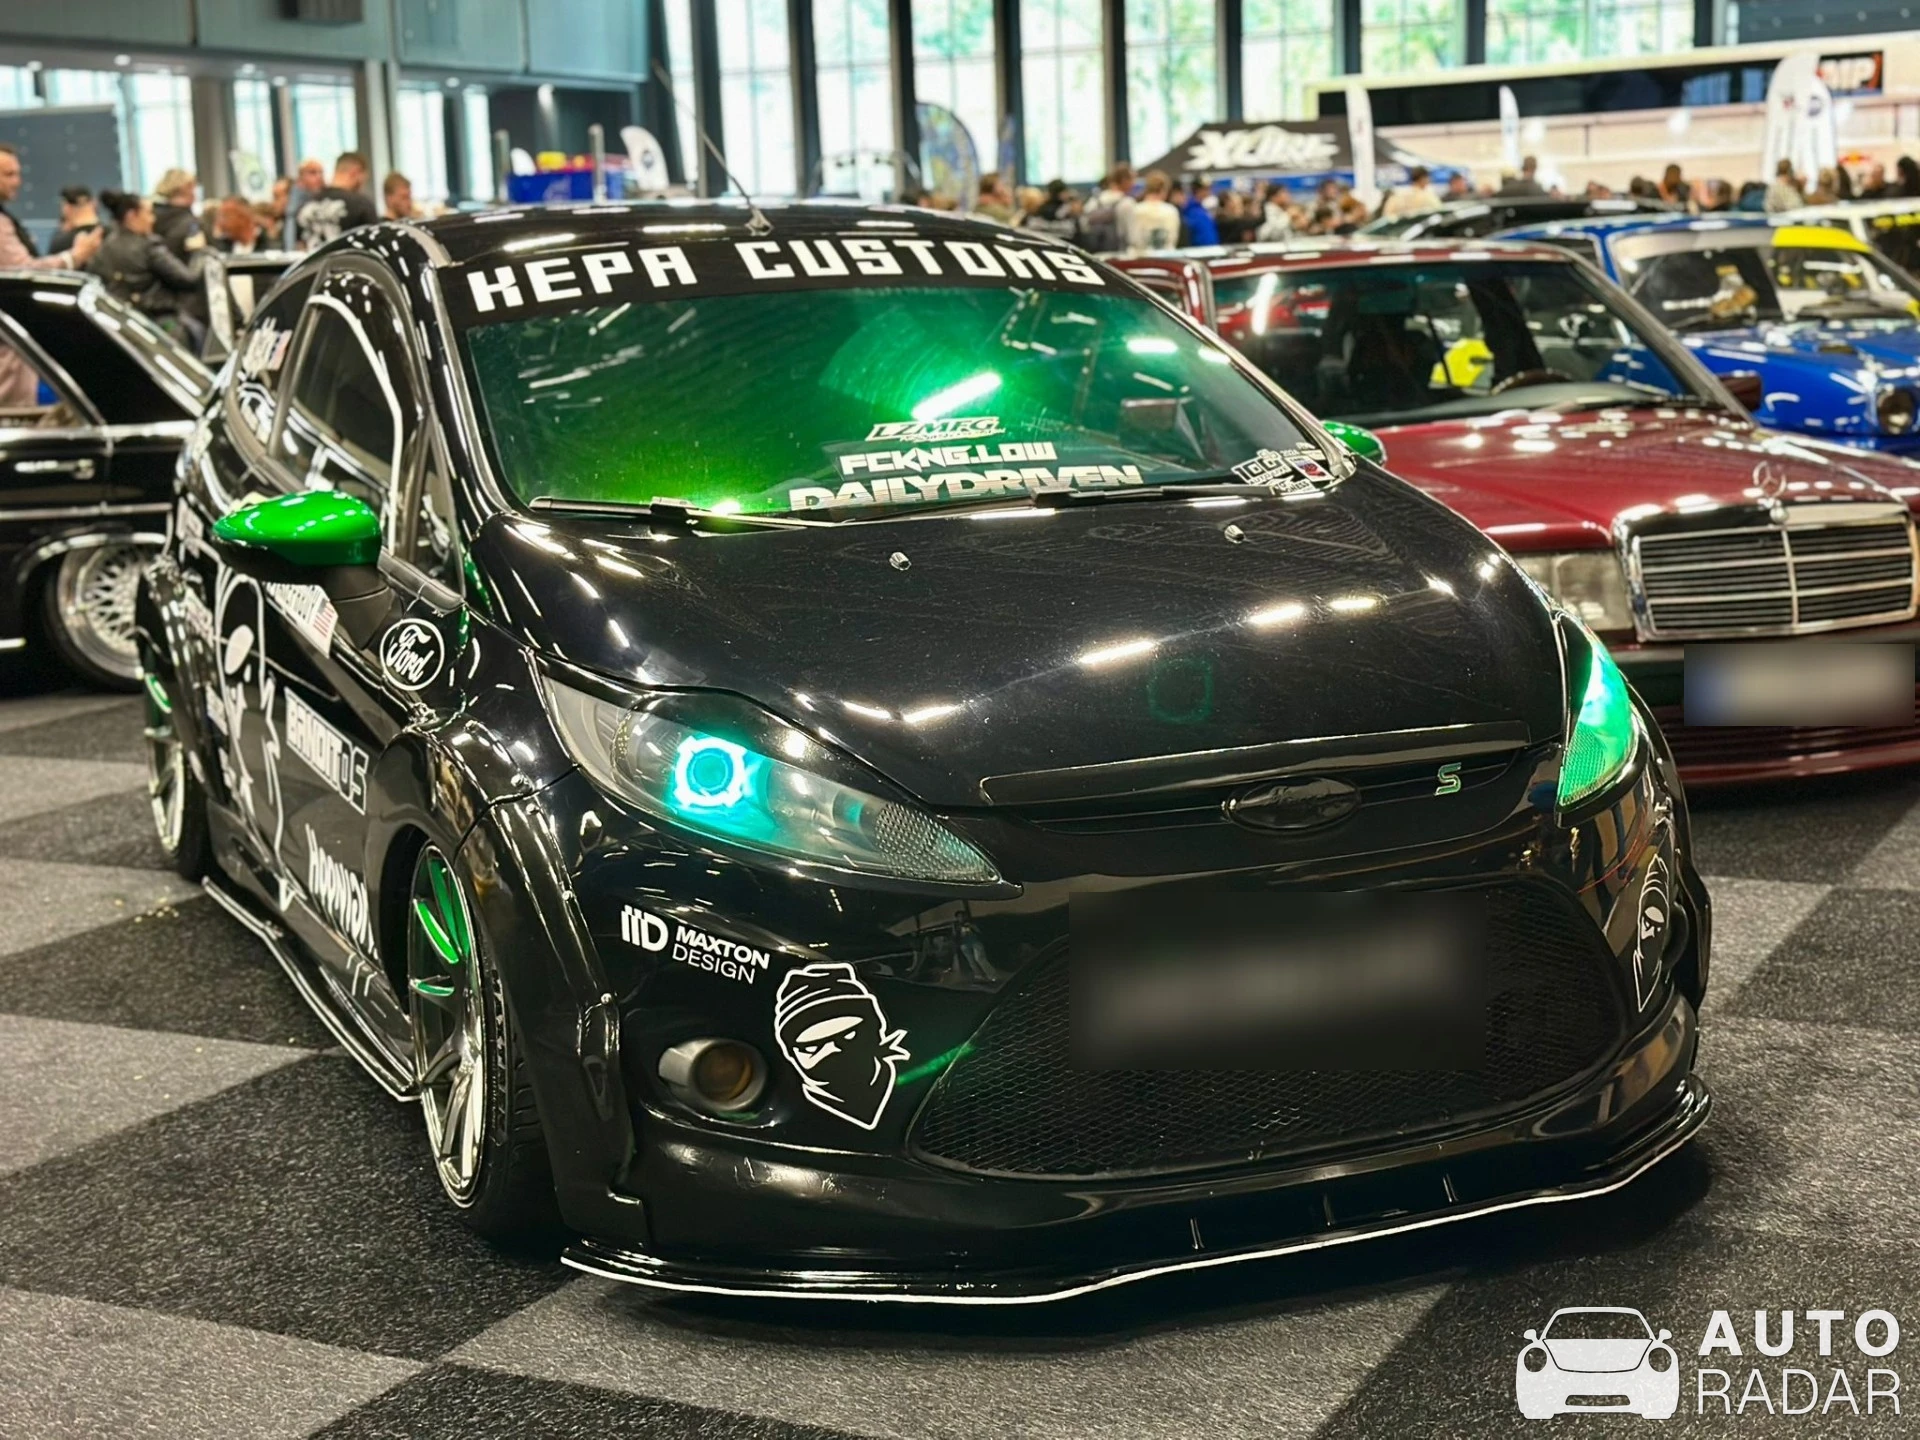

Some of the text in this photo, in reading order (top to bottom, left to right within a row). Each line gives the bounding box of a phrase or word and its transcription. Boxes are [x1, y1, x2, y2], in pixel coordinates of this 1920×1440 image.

[467, 239, 1106, 313] KEPA CUSTOMS
[839, 441, 1058, 475] FCKNG.LOW
[789, 465, 1144, 511] DAILYDRIVEN
[386, 624, 435, 683] Ford
[1433, 762, 1462, 796] S
[672, 943, 756, 985] DESIGN
[675, 925, 771, 970] MAXTON
